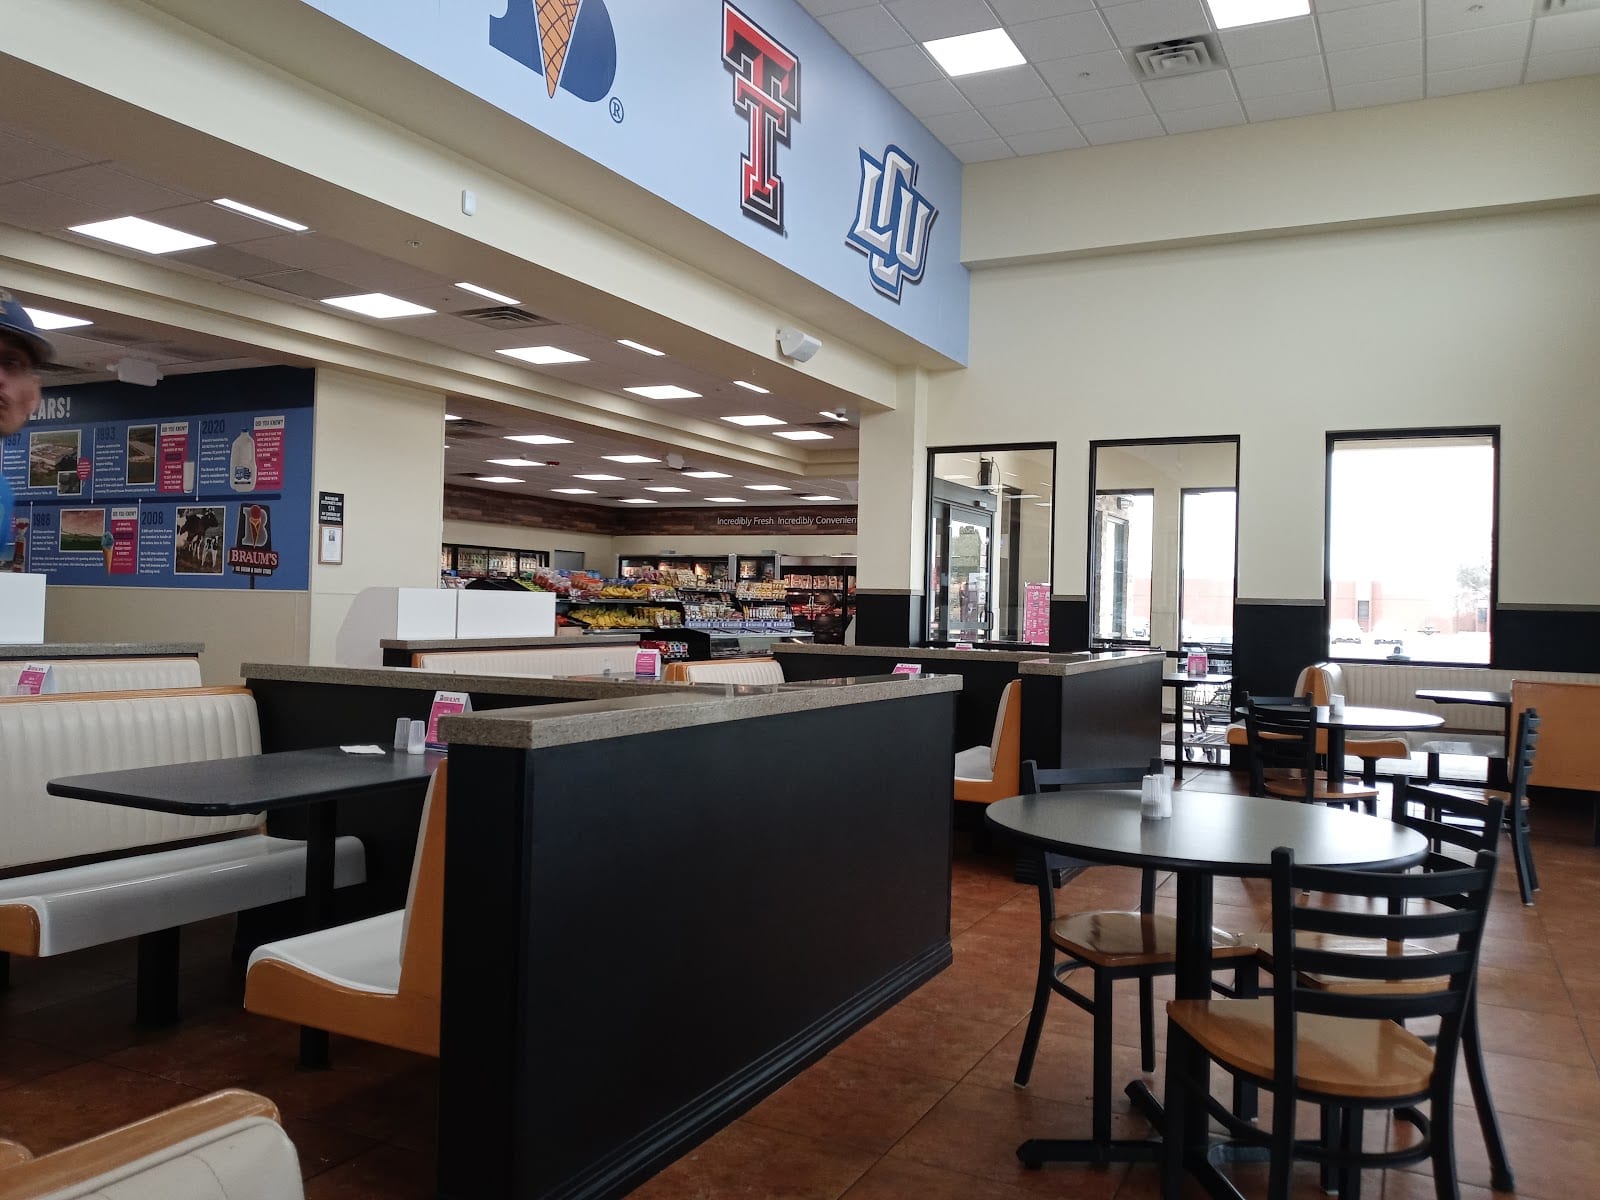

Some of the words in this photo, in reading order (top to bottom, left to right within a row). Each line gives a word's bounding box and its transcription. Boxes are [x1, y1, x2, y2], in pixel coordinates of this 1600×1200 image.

[201, 419, 225, 434] 2020
[141, 510, 164, 525] 2008
[717, 516, 752, 527] Incredibly
[777, 515, 814, 526] Incredibly
[815, 515, 857, 525] Convenien
[231, 549, 278, 566] BRAUM'S
